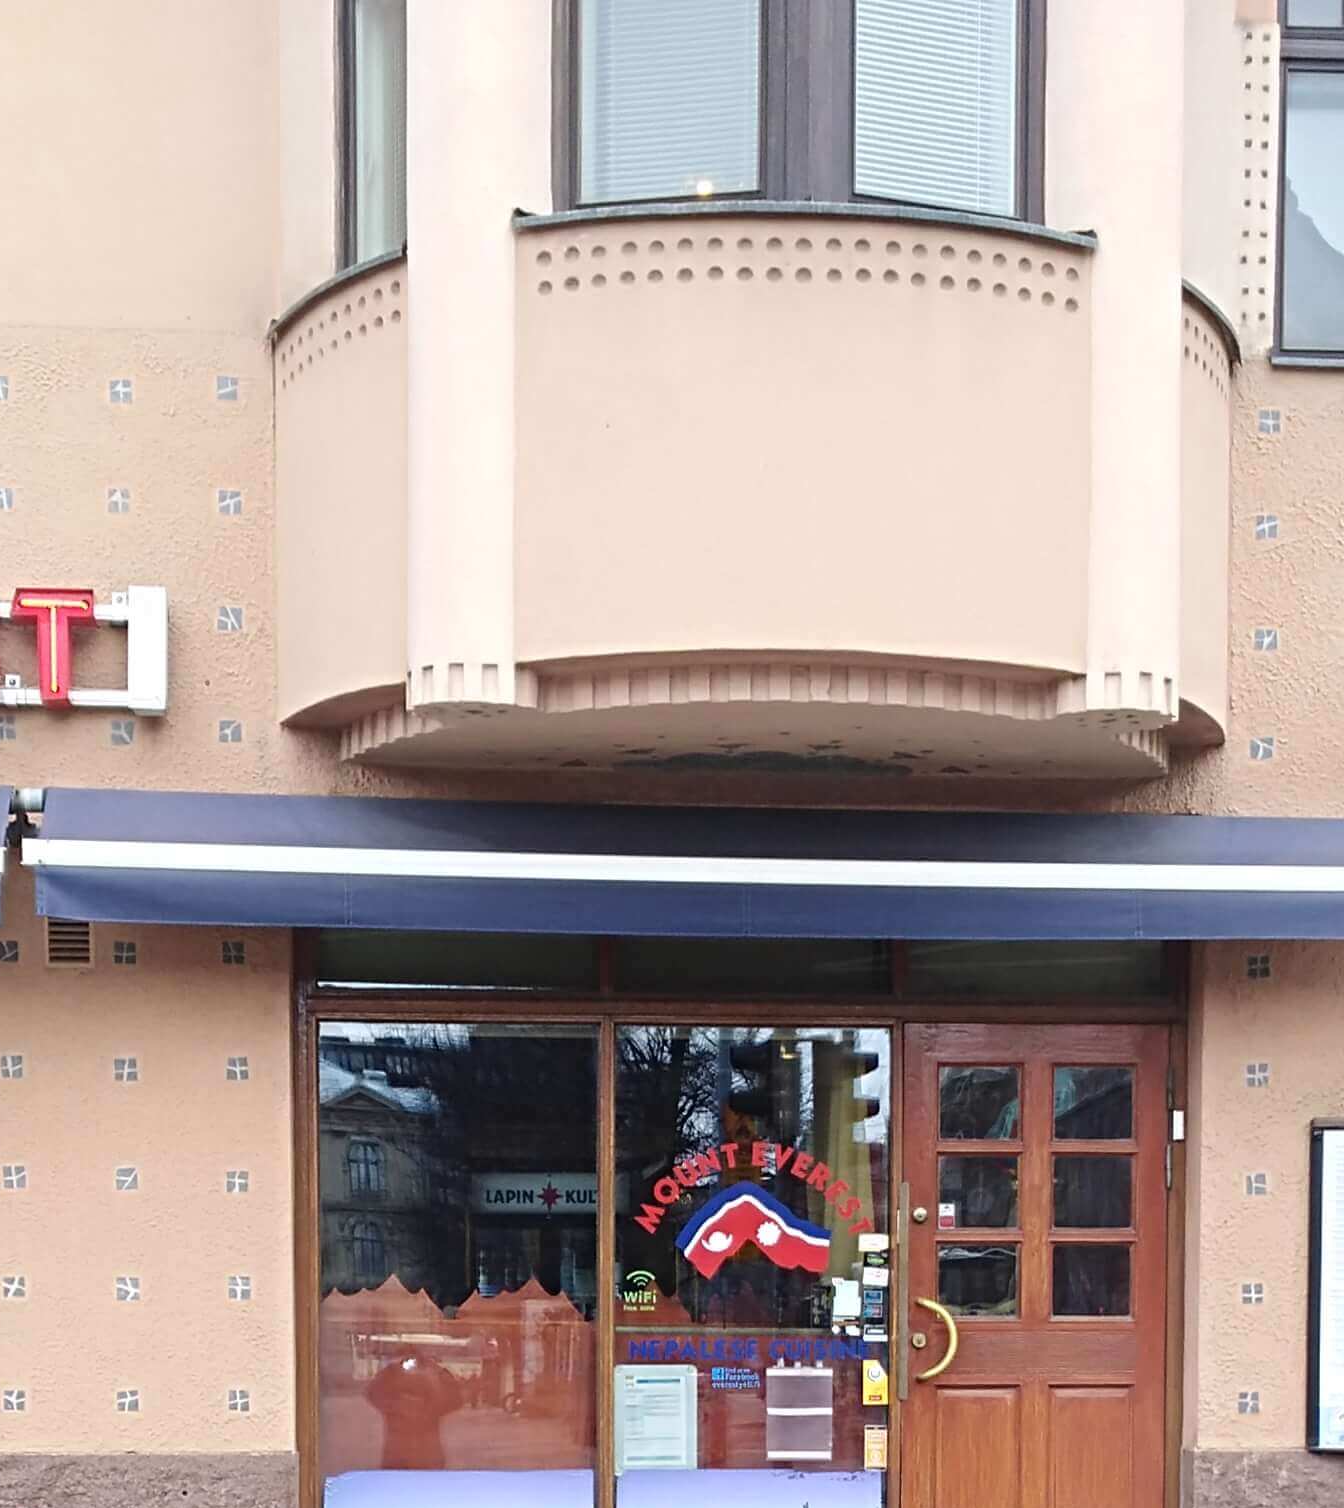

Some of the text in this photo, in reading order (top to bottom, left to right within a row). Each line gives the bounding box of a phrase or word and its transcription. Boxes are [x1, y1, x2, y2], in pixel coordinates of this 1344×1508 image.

[485, 1189, 598, 1204] LAPIN KUL
[633, 1140, 874, 1235] MOUNT EVEREST
[623, 1289, 657, 1304] WiFi
[628, 1339, 872, 1361] NEPALESE CUISINE
